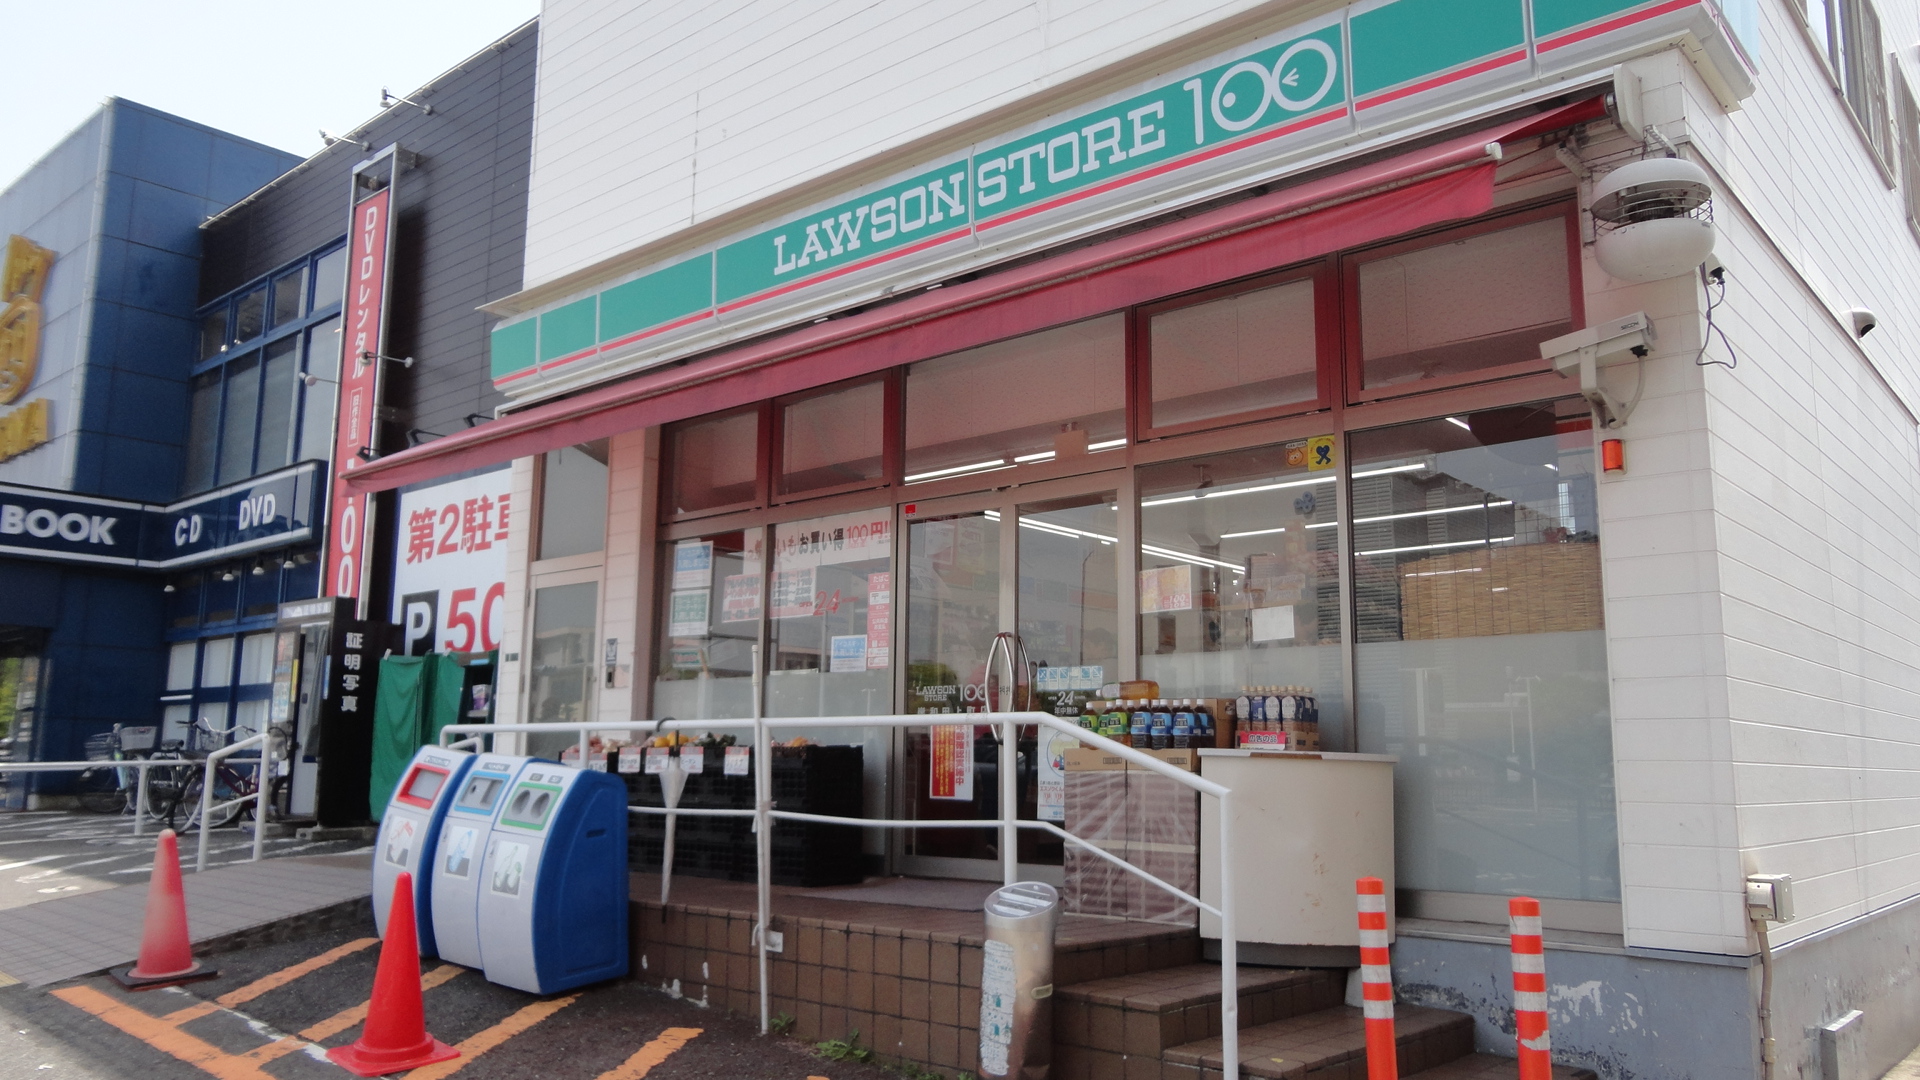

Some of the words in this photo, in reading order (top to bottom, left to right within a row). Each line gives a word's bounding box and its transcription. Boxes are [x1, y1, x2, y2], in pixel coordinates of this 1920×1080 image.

[774, 171, 966, 276] LAWSON
[977, 100, 1166, 206] STORE
[1183, 38, 1338, 145] 100
[352, 206, 378, 379] DVDレンタル
[1, 504, 117, 546] BOOK
[238, 493, 276, 531] DVD
[174, 514, 202, 547] CD
[872, 574, 889, 584] たばこ
[813, 589, 841, 616] 24
[405, 601, 431, 656] P
[341, 632, 364, 713] 証明写真
[915, 685, 956, 695] LAWSON
[1054, 706, 1079, 715] 年中無休
[1056, 691, 1075, 705] 24
